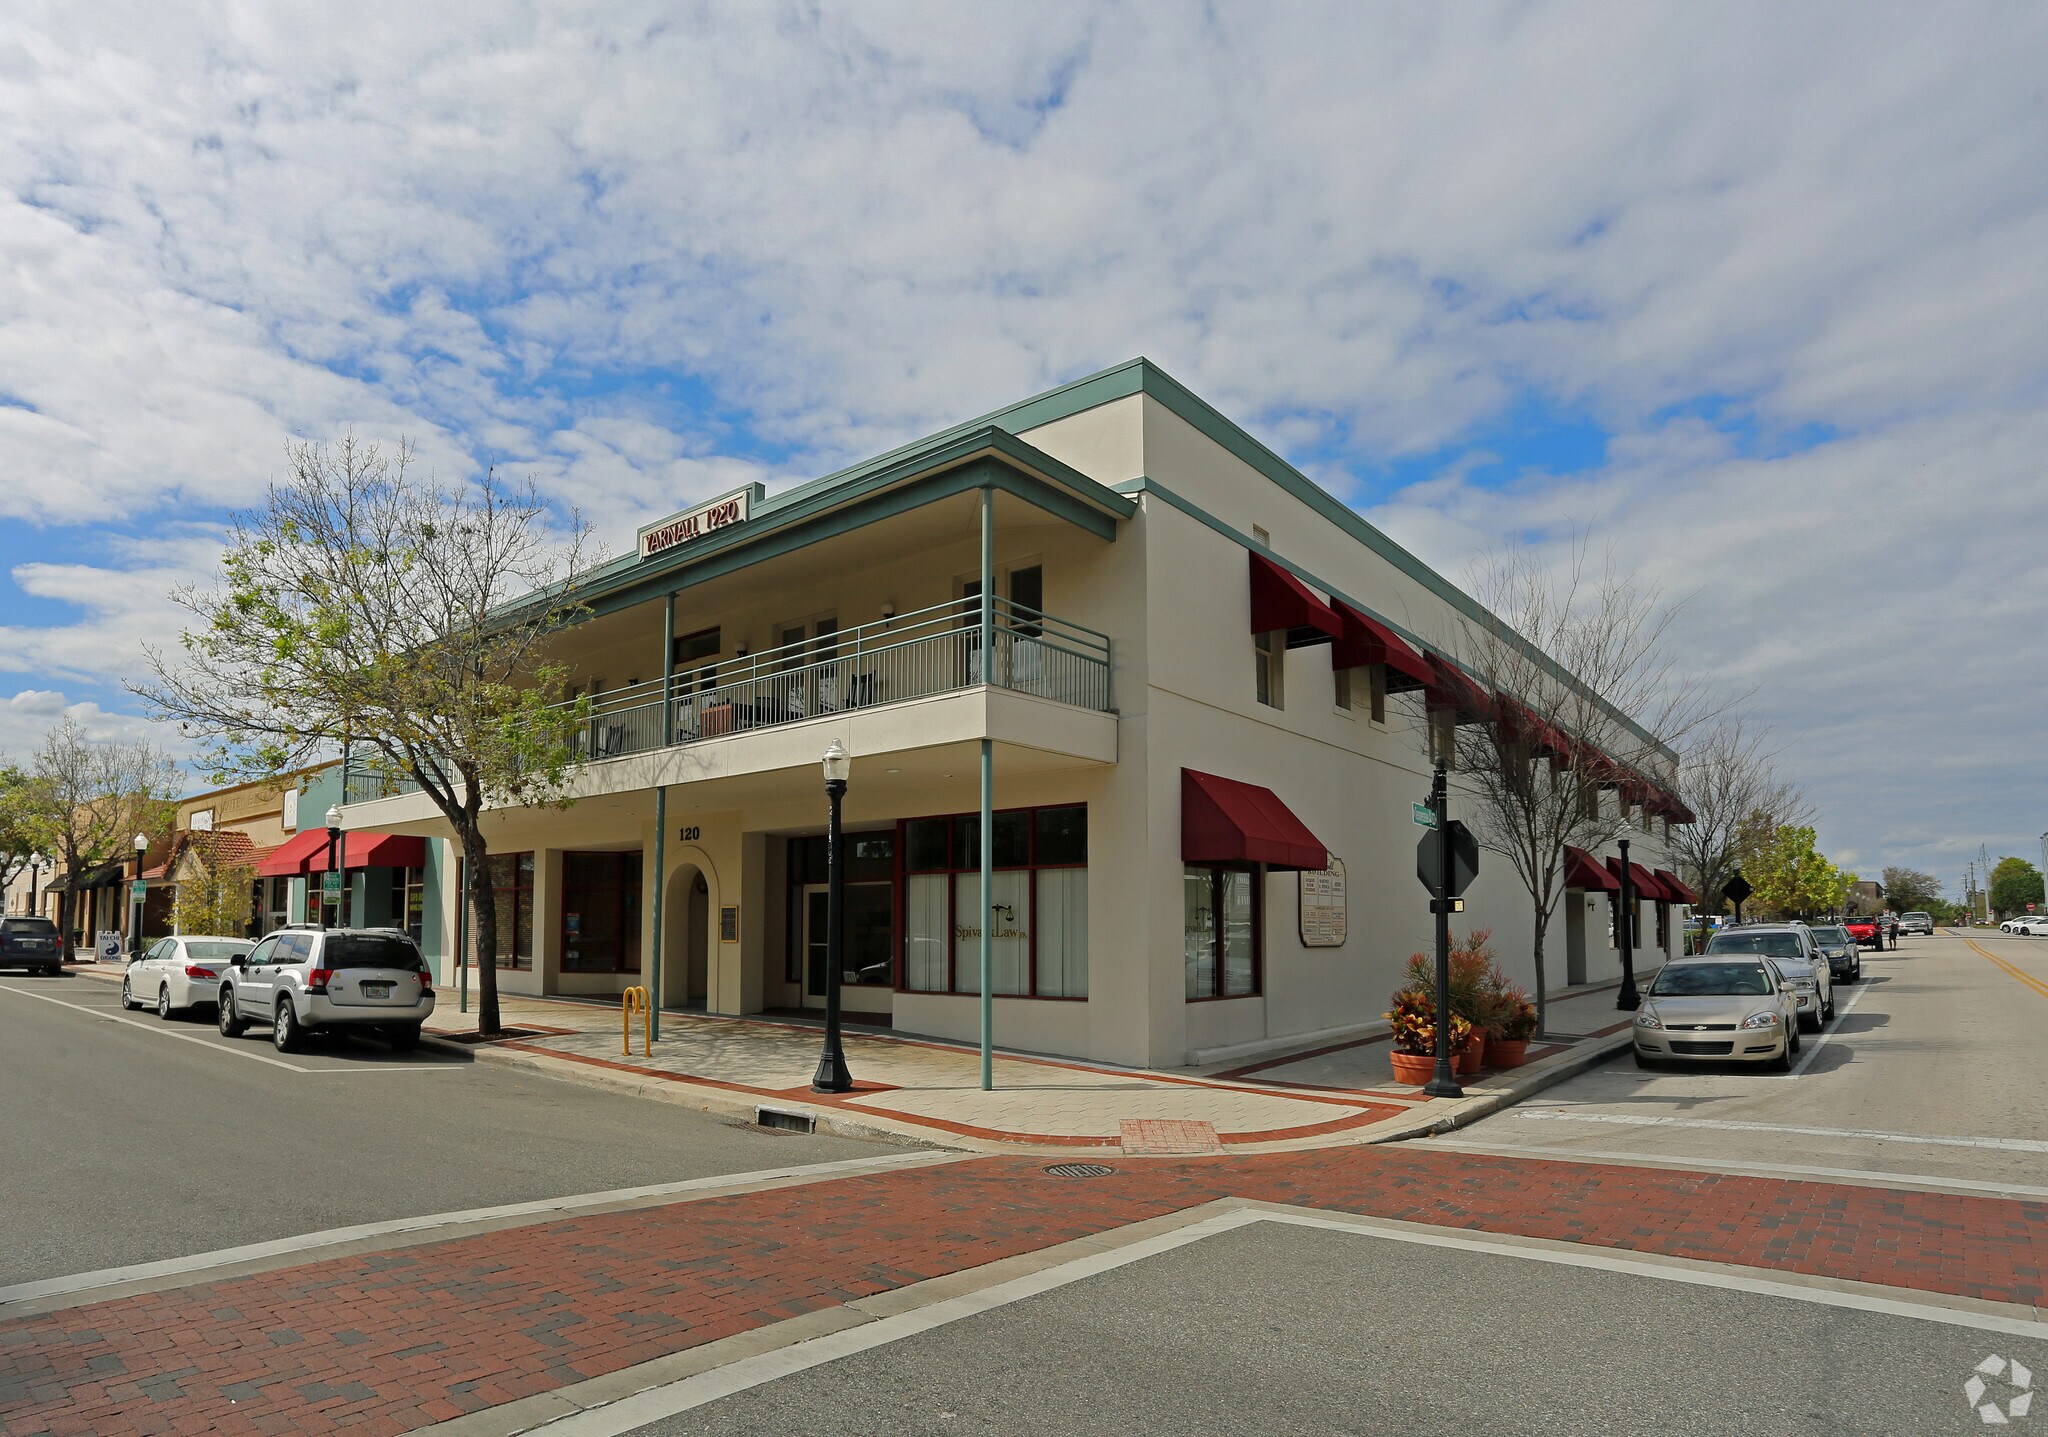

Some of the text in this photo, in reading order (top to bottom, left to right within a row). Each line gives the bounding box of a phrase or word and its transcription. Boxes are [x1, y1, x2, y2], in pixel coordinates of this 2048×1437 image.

[646, 500, 739, 553] YARNALL 1920
[680, 826, 700, 841] 120
[956, 925, 995, 941] Spivak
